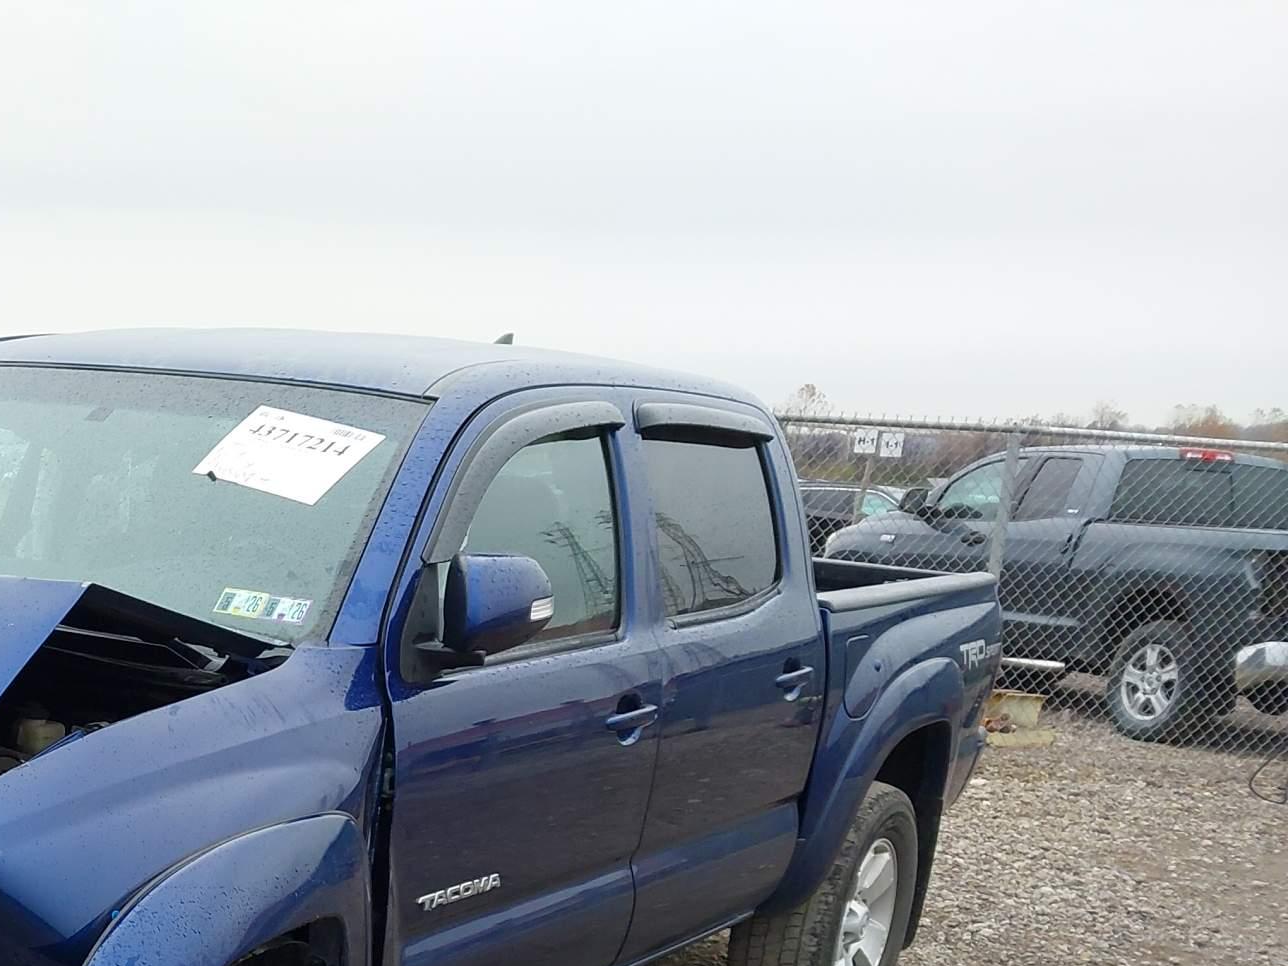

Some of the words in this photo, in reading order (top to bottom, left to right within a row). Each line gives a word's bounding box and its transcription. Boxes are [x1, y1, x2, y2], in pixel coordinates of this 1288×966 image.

[249, 424, 352, 457] 43717214
[959, 638, 986, 670] TRD
[415, 873, 501, 911] TACOMA
